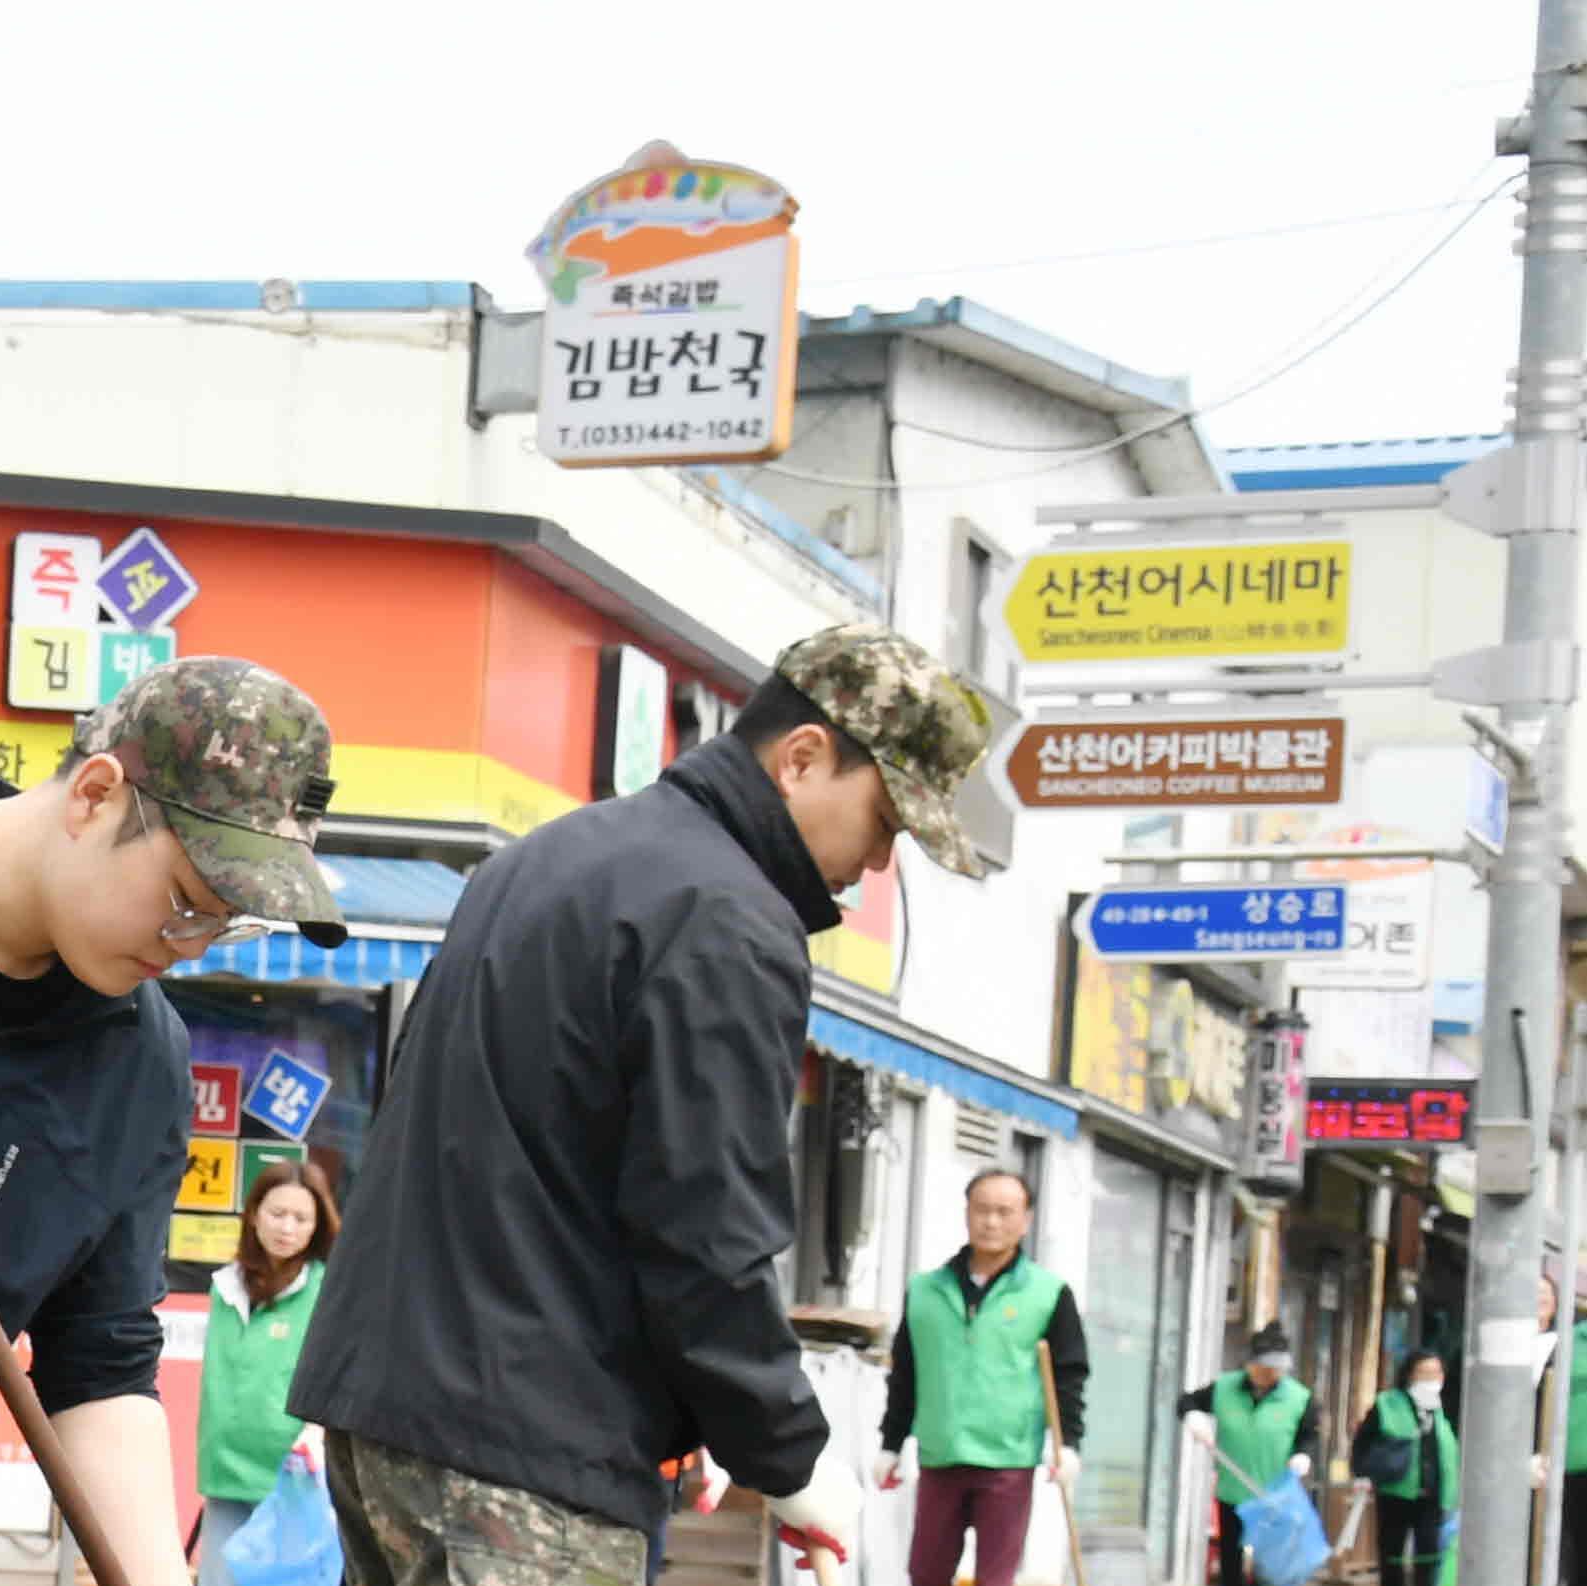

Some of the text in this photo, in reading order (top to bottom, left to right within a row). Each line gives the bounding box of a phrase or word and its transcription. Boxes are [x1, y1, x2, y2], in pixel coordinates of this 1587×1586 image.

[555, 330, 767, 401] 김밥천국
[1036, 557, 1342, 619] 산천어시네마
[1037, 728, 1331, 773] 산천어커피박물관
[1241, 889, 1339, 924] 상승로
